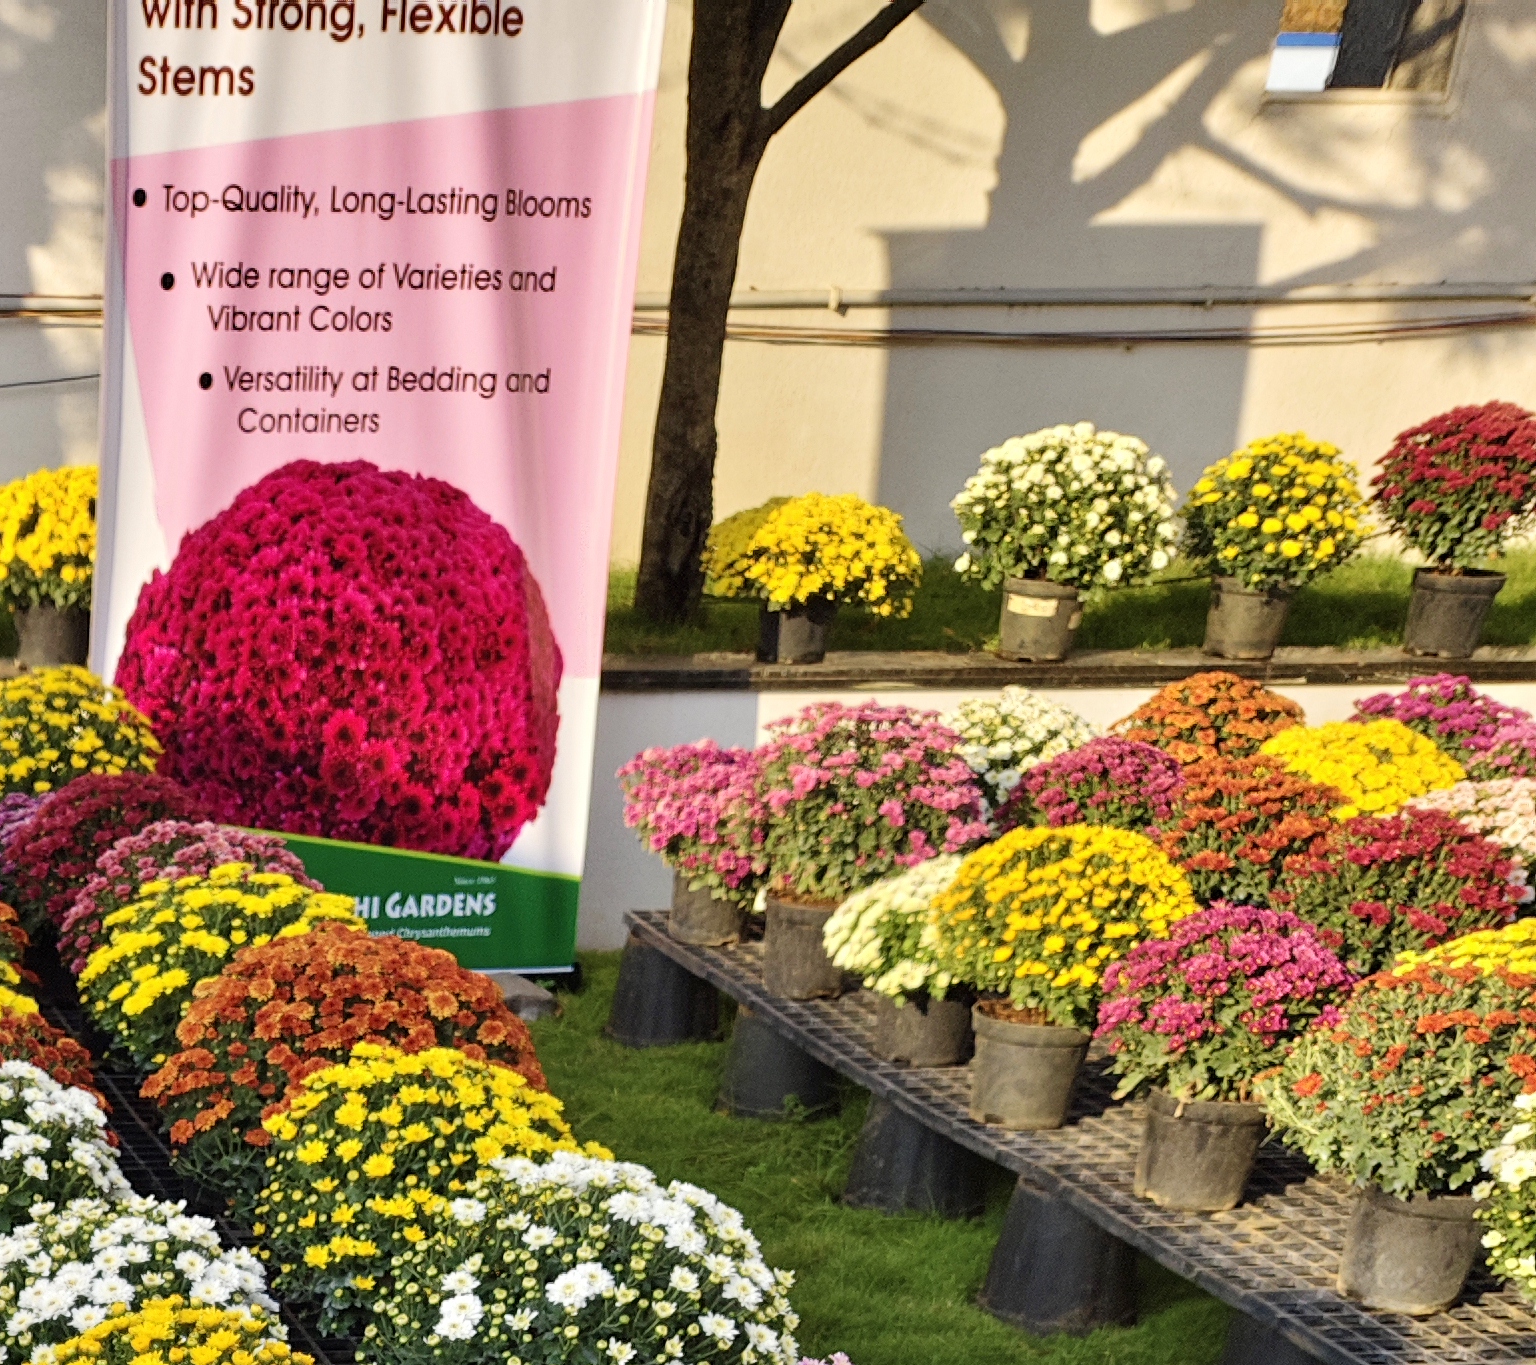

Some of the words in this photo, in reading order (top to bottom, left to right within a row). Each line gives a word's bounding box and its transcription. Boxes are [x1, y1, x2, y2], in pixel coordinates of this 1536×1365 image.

[141, 0, 217, 29] with
[232, 0, 366, 42] Strong,
[381, 0, 524, 37] Flexible
[137, 55, 255, 96] Stems
[162, 184, 320, 219] Top-Quality,
[330, 185, 498, 222] Long-Lasting
[505, 189, 592, 218] Blooms
[191, 262, 260, 288] Wide
[268, 267, 350, 296] range
[358, 263, 387, 289] of
[393, 263, 502, 290] Varieties
[508, 266, 558, 292] and
[207, 305, 301, 331] Vibrant
[309, 305, 394, 332] Colors
[223, 365, 344, 398] Versatility
[352, 366, 379, 392] at
[387, 366, 498, 399] Bedding
[505, 368, 552, 394] and
[237, 407, 381, 434] Containers
[384, 890, 498, 920] GARDENS
